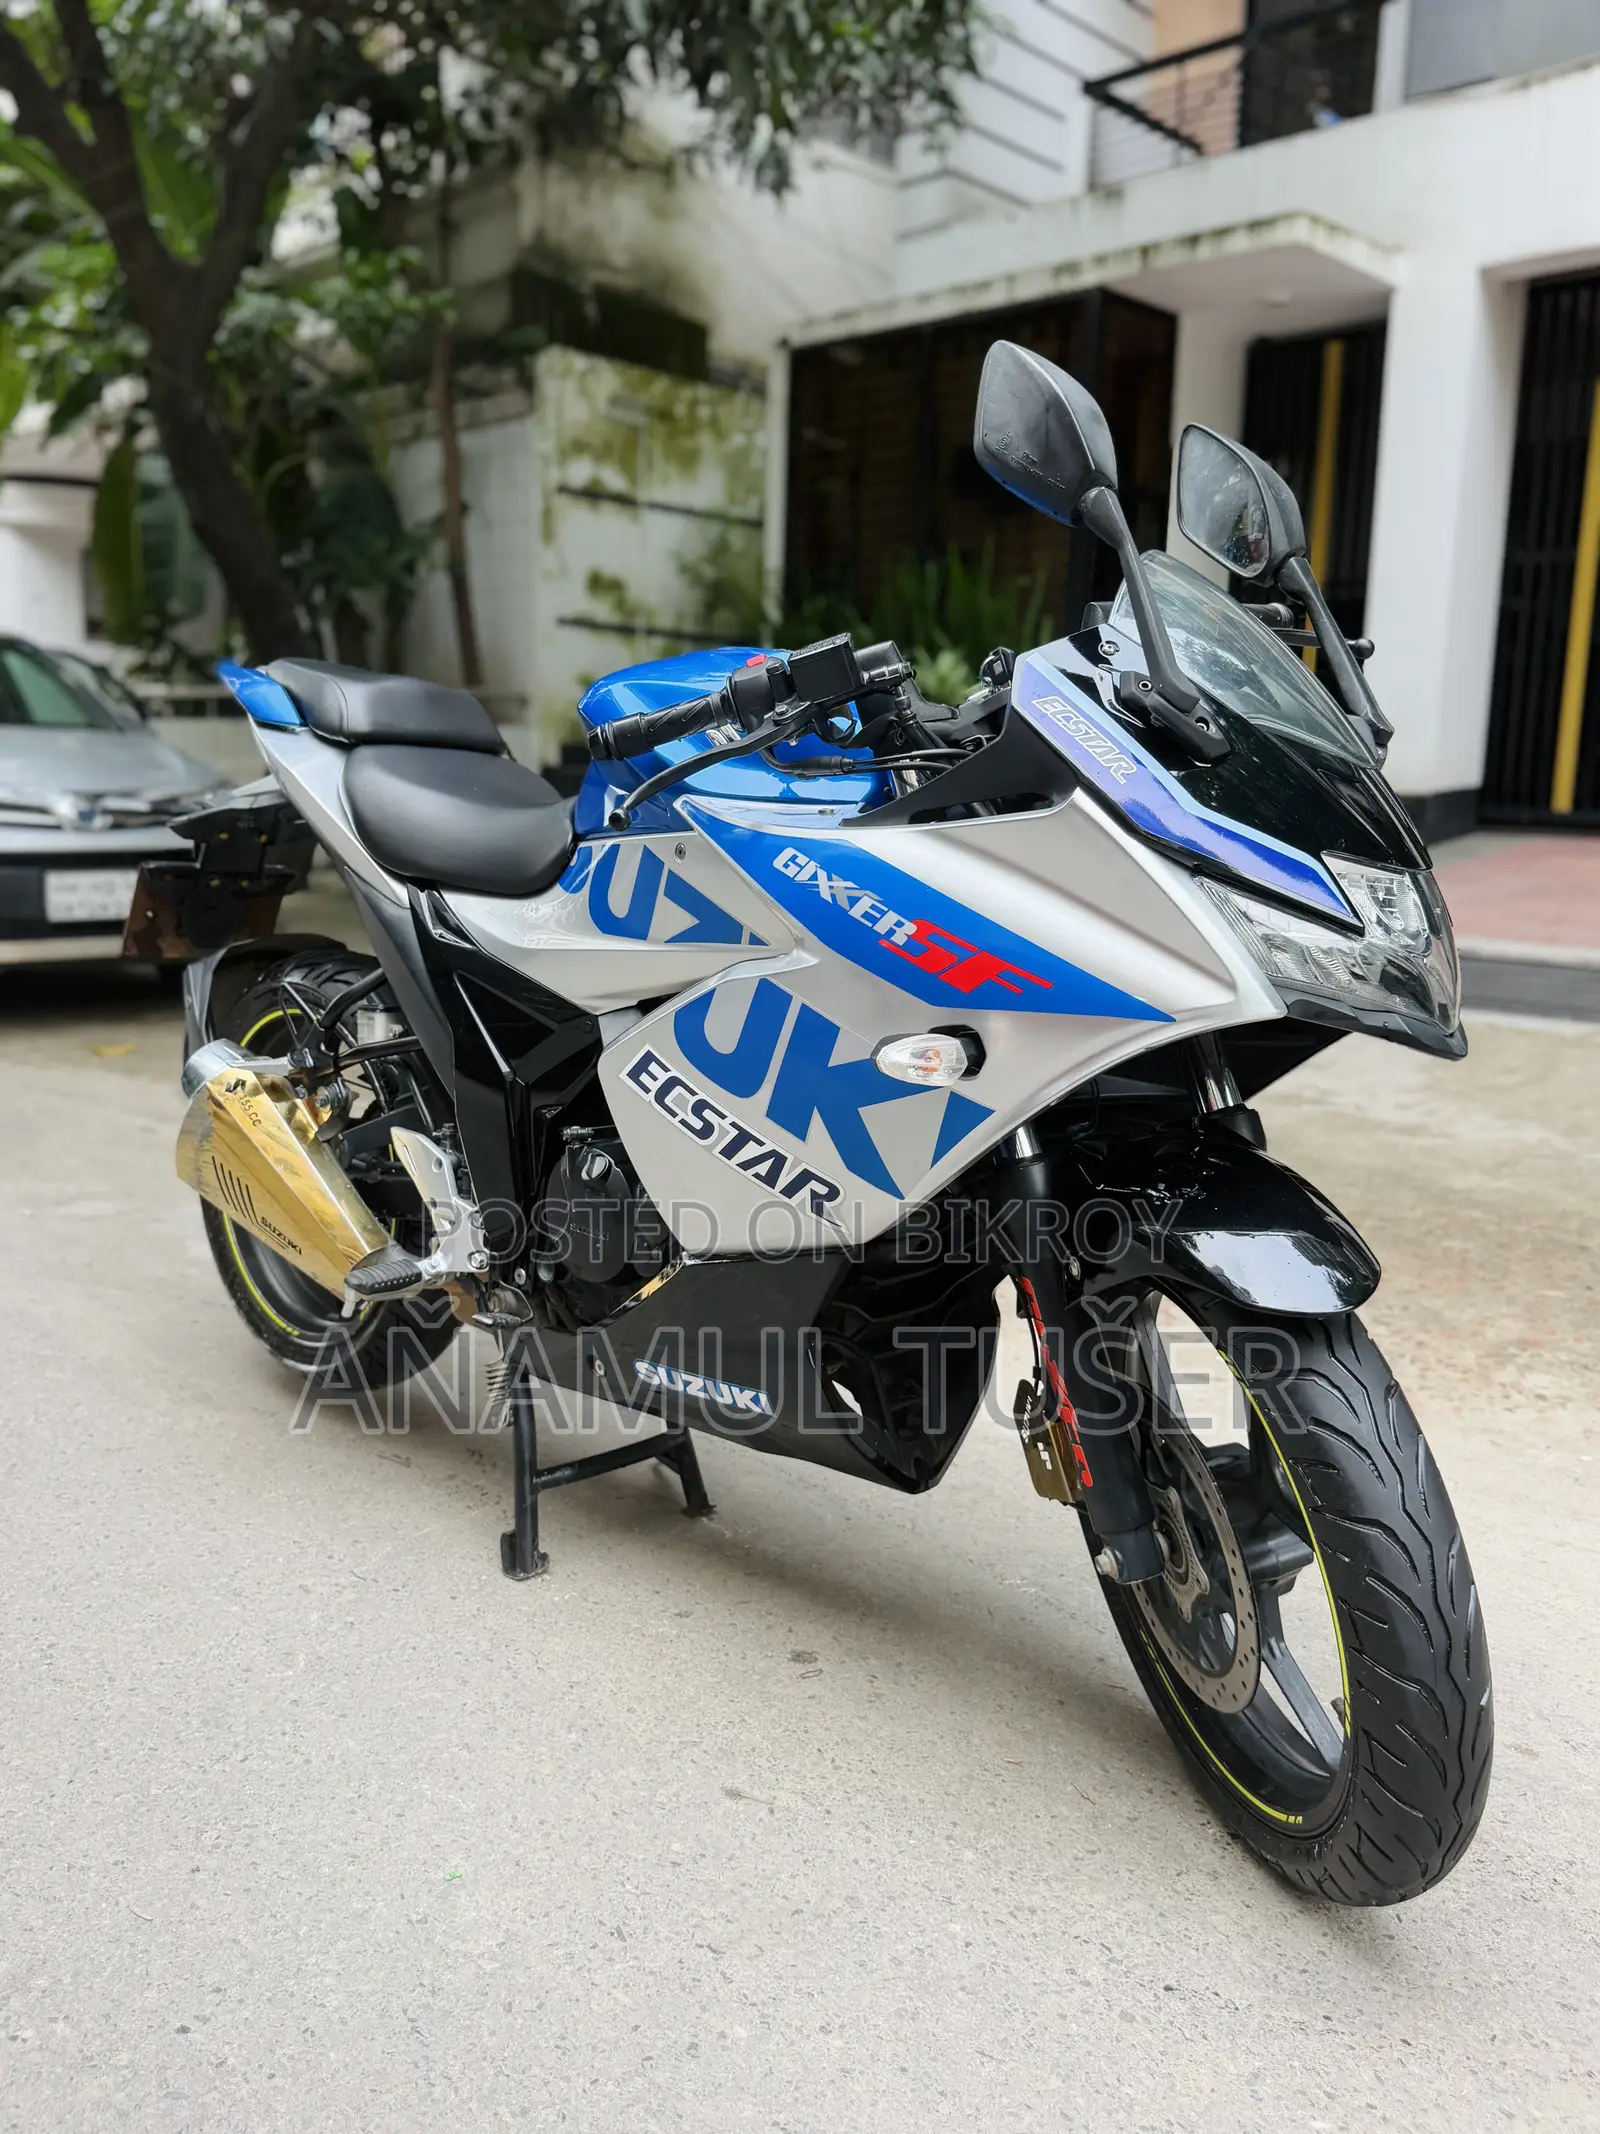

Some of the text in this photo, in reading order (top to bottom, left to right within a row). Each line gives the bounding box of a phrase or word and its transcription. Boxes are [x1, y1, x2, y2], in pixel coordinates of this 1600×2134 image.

[1031, 696, 1137, 785] ECSTAR
[772, 846, 1055, 994] GIXXER SF
[626, 1049, 845, 1231] ECSTAR
[260, 1216, 303, 1256] SUZUKI
[635, 1361, 775, 1417] SUZUKI
